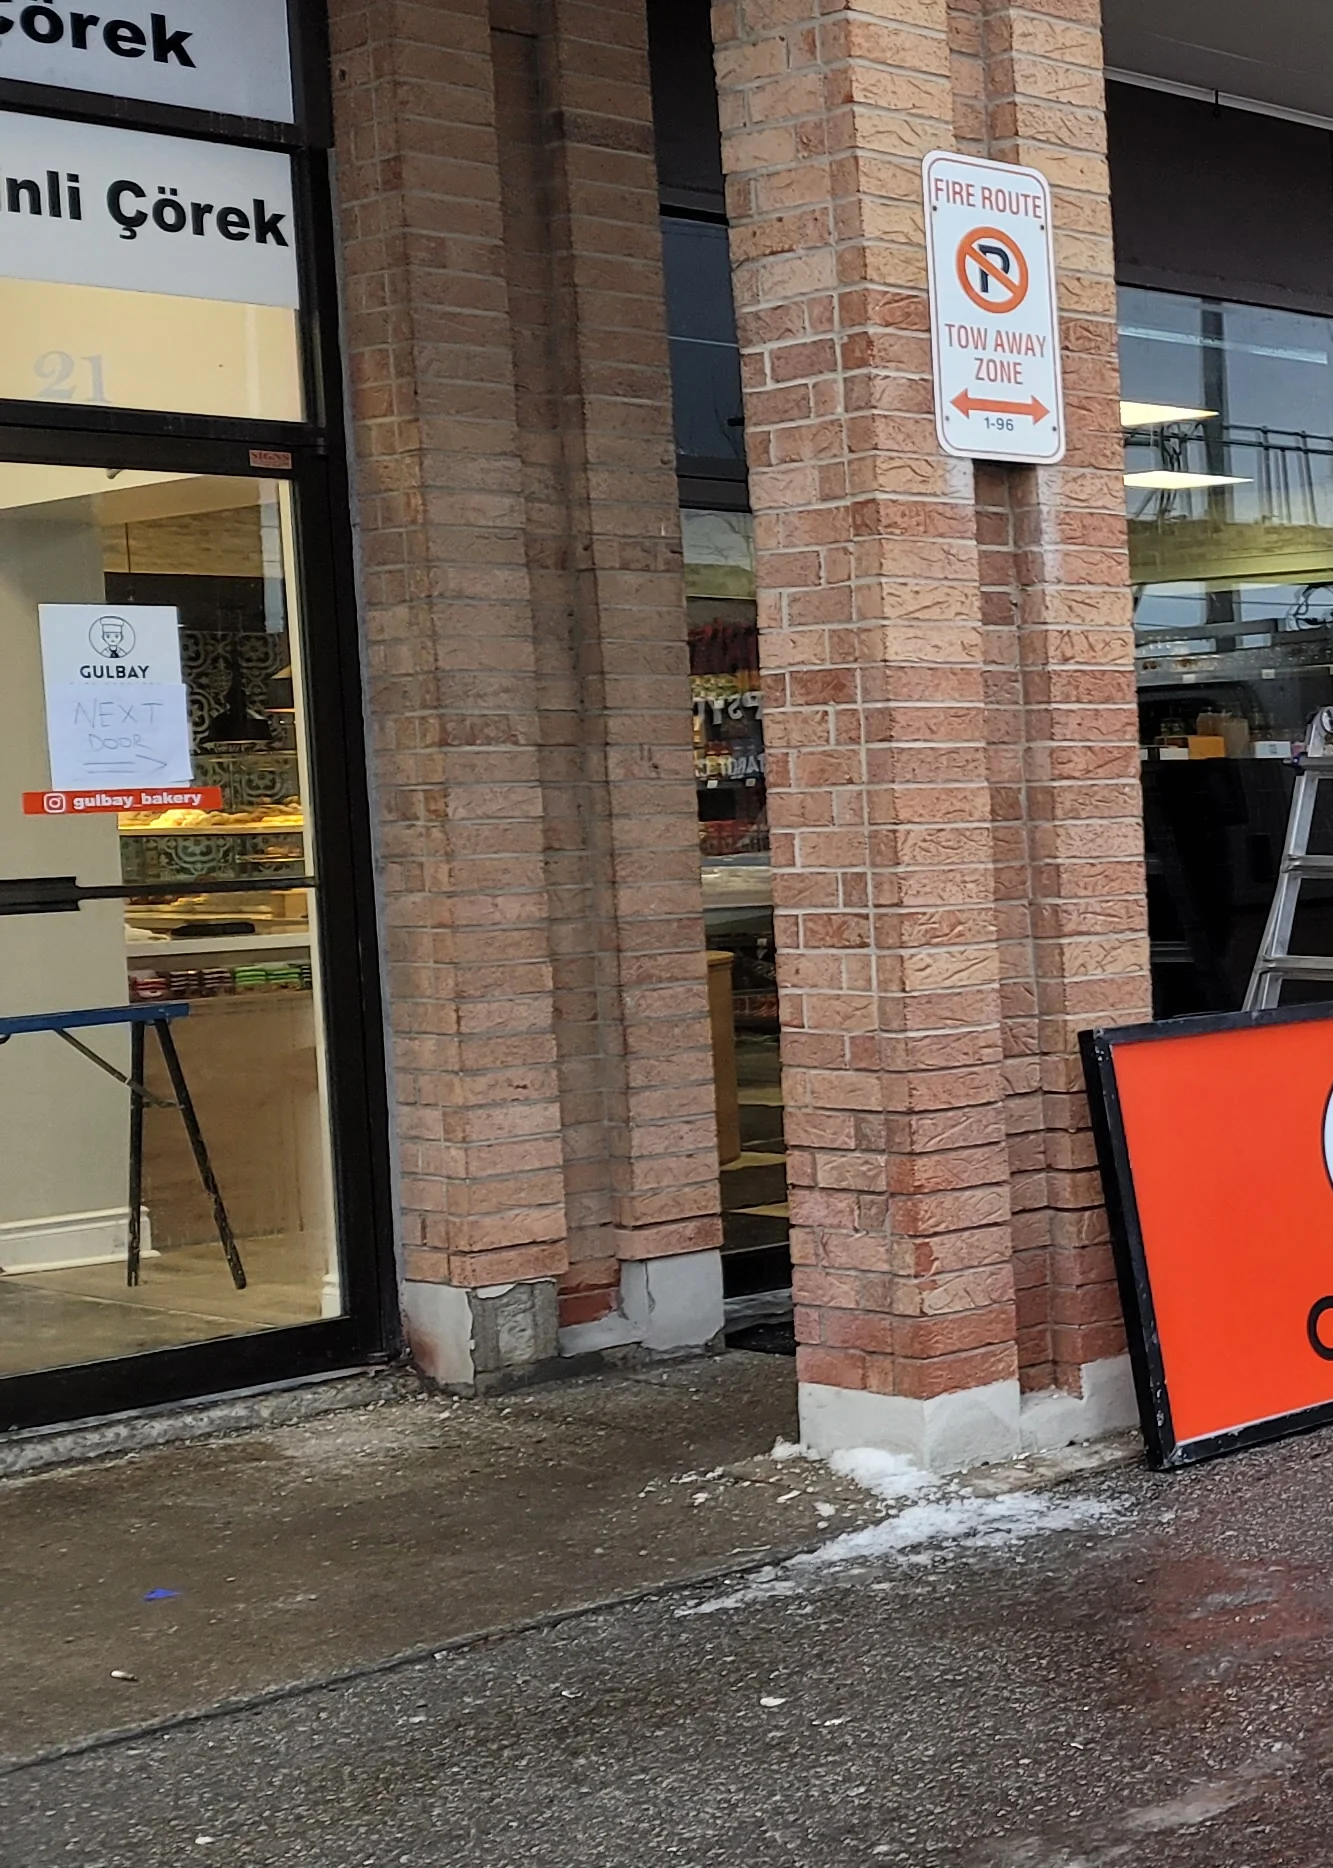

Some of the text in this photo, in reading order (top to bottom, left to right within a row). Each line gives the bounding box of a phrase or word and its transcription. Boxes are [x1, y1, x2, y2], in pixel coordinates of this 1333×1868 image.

[0, 0, 197, 68] örek
[0, 170, 289, 247] nli Çörek
[934, 177, 1042, 219] FIRE ROUTE
[944, 323, 1046, 358] TOW AWAY
[33, 351, 112, 403] 21
[974, 357, 1023, 385] ZONE
[984, 416, 1014, 431] 1-96
[79, 665, 150, 679] GULBAY
[73, 698, 164, 729] NEXT
[87, 732, 151, 752] DOOR
[73, 793, 202, 809] gulbay_bakery
